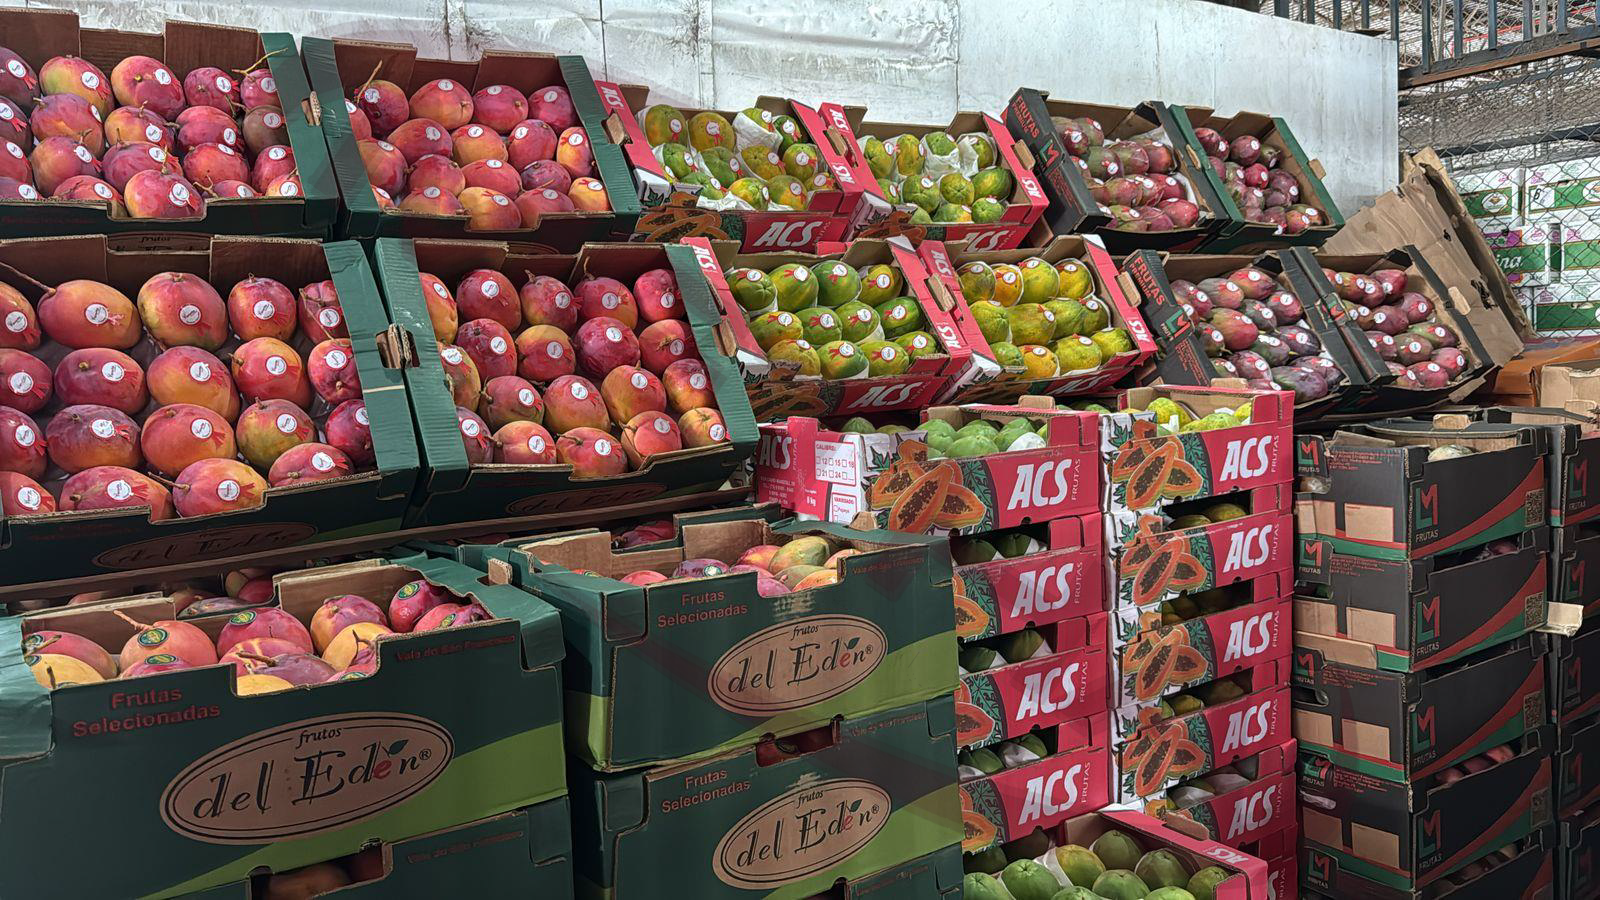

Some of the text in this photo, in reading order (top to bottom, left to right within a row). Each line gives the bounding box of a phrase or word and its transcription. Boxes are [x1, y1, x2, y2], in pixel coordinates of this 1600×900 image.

[752, 221, 823, 247] ACS
[1133, 255, 1165, 305] FRUTAS
[847, 381, 923, 409] ACS
[759, 434, 793, 470] ACS
[821, 456, 828, 465] 12
[834, 458, 841, 466] 15
[1219, 435, 1272, 482] ACS
[1271, 434, 1280, 473] FRUTAS
[1007, 459, 1073, 511] ACS
[1072, 458, 1081, 501] FRUTAS
[1222, 524, 1273, 573] ACS
[1271, 523, 1280, 561] FRUTAS
[1415, 530, 1439, 543] FRUTAS
[681, 591, 725, 607] Frutas
[1010, 563, 1074, 618] ACS
[1074, 562, 1083, 604] FRUTAS
[657, 603, 748, 628] Selecionadas
[790, 624, 820, 641] frutos
[1272, 610, 1280, 648] FRUTAS
[1223, 611, 1273, 663] ACS
[1416, 642, 1440, 656] FRUTAS
[727, 648, 778, 693] del
[1079, 661, 1089, 703] FRUTAS
[111, 687, 183, 709] Frutas
[1016, 662, 1080, 722] ACS
[73, 704, 221, 737] Selecionadas
[1221, 700, 1272, 754] ACS
[1270, 698, 1279, 735] FRUTAS
[296, 727, 342, 749] frutos
[1412, 750, 1437, 766] FRUTAS
[193, 759, 274, 819] del
[661, 780, 751, 814] Selecionadas
[685, 769, 728, 790] Frutas
[1018, 763, 1082, 826] ACS
[1081, 762, 1091, 803] FRUTAS
[796, 790, 824, 809] frutos
[1227, 784, 1277, 840] ACS
[736, 818, 784, 868] del
[1418, 854, 1443, 871] FRUTAS
